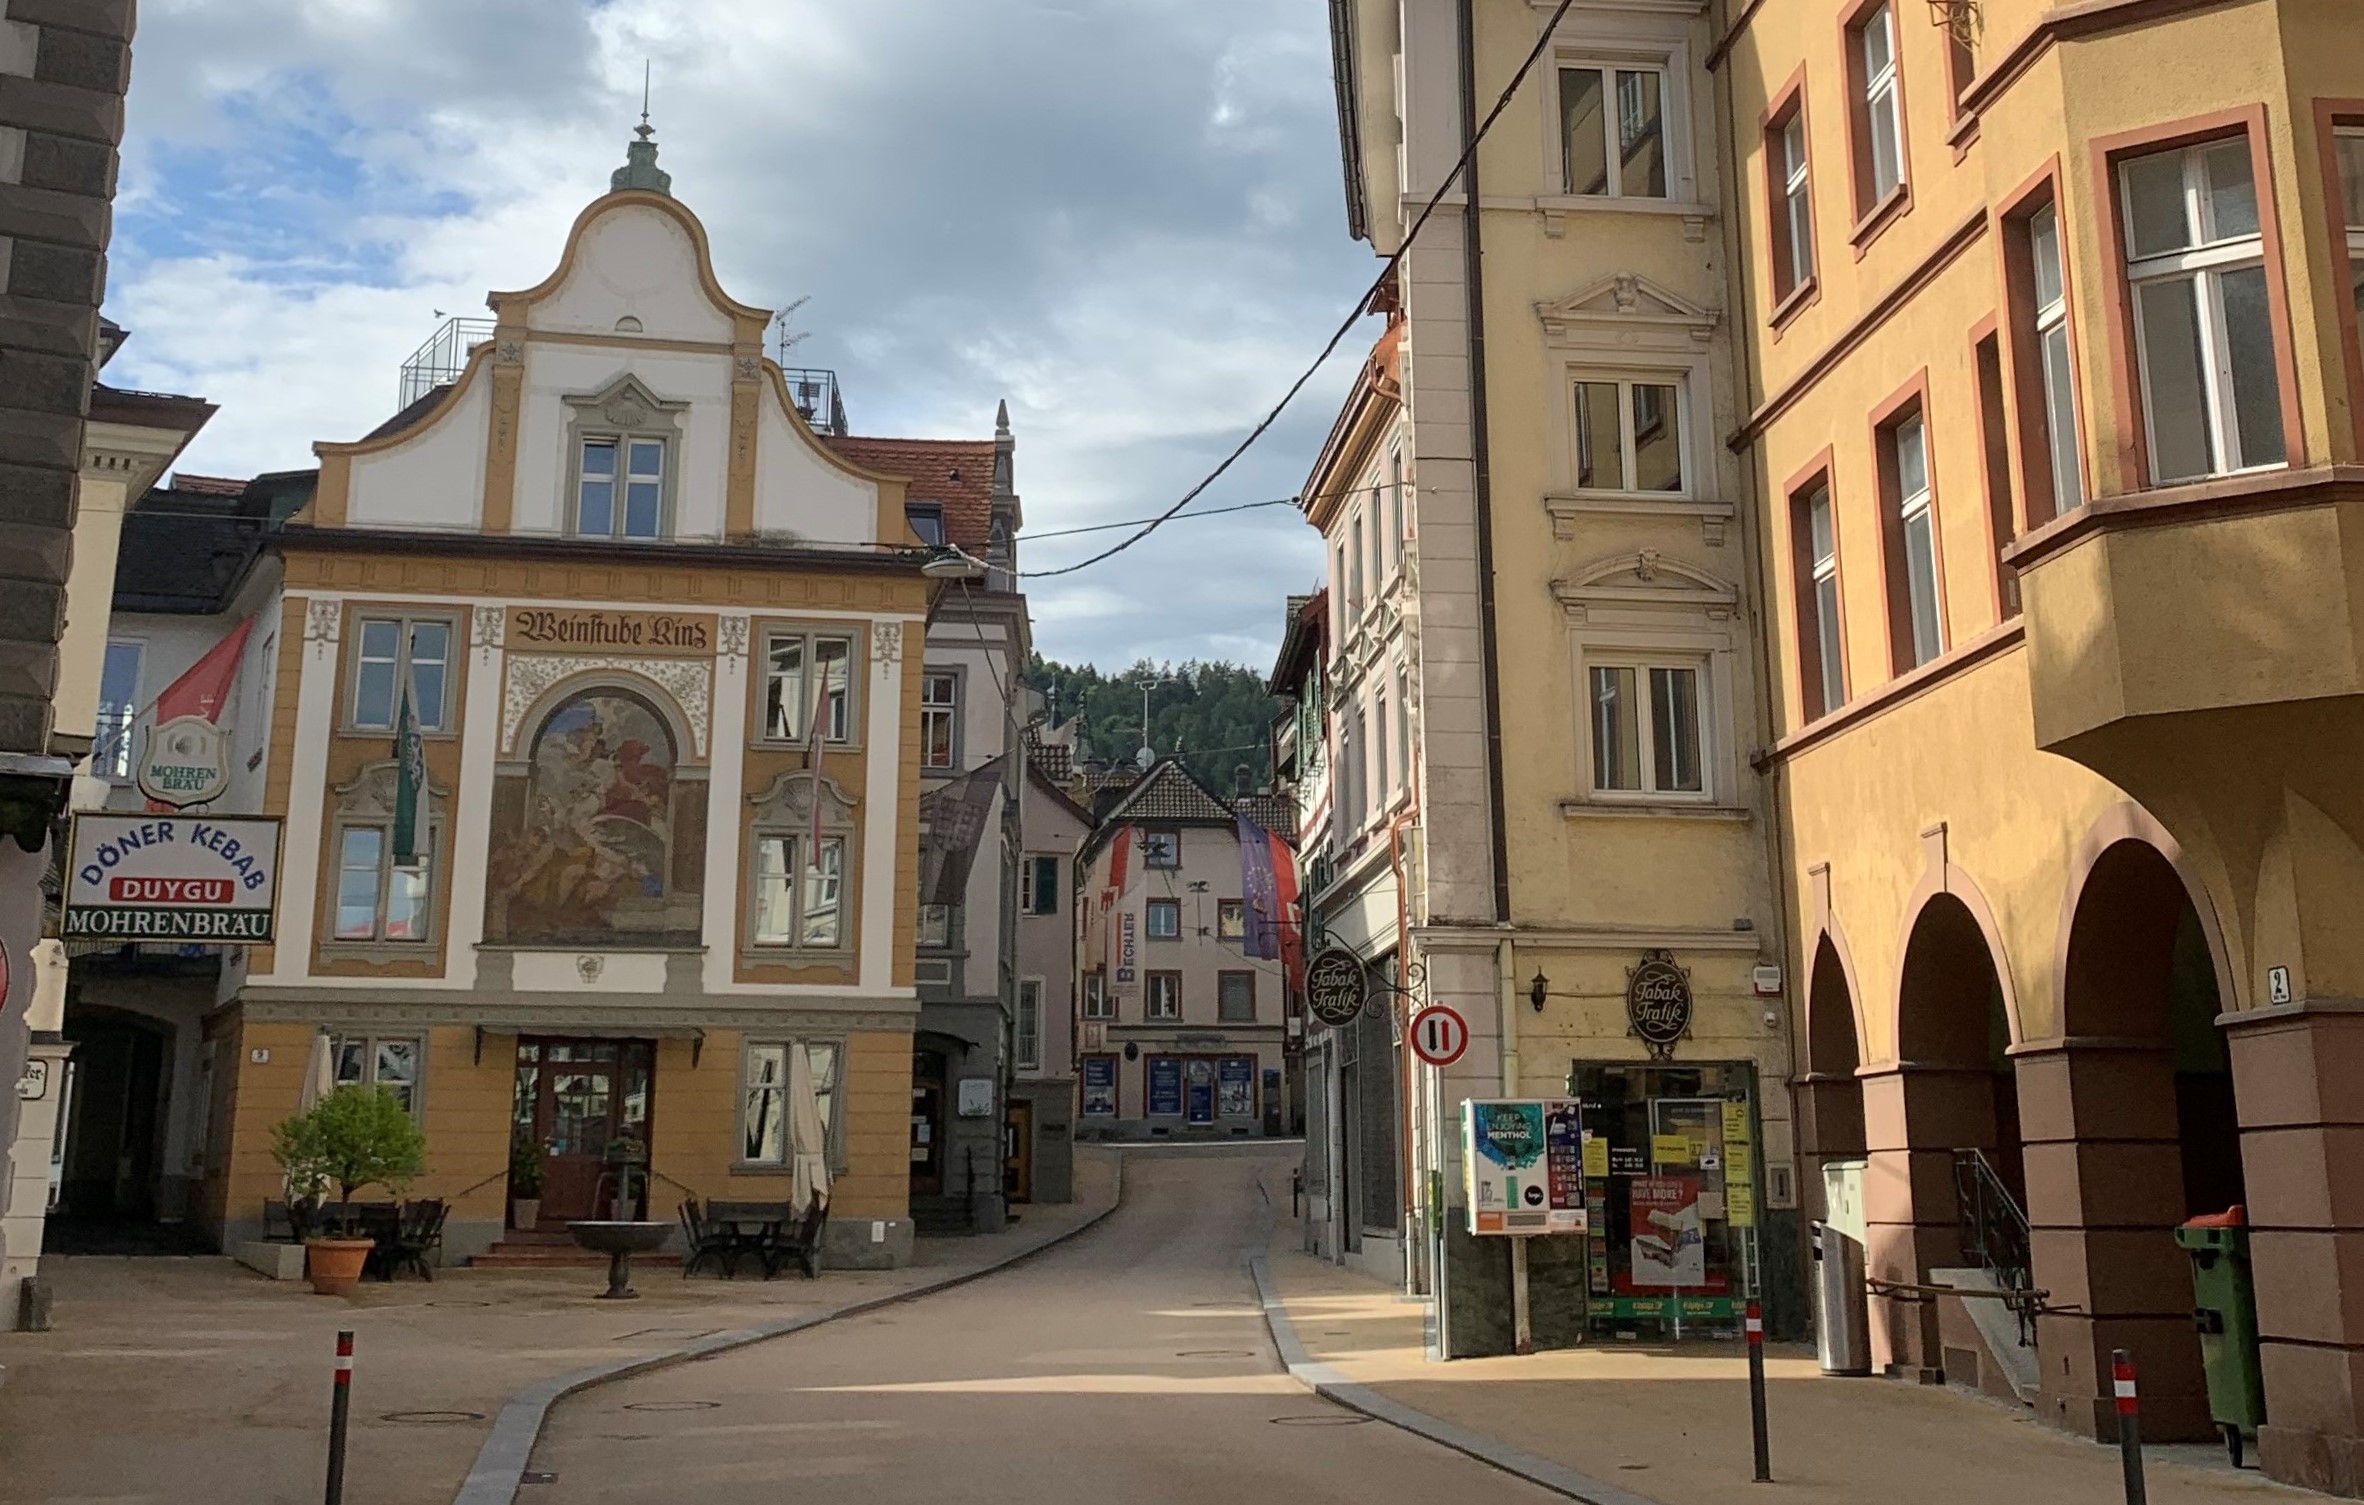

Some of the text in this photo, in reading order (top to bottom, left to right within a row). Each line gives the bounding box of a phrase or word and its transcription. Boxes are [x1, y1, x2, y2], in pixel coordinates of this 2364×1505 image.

[648, 615, 707, 649] Kinz
[150, 764, 217, 780] MOHREN
[162, 777, 205, 791] BRÄU
[80, 821, 265, 890] DÖNER KEBAB
[122, 880, 222, 900] DUYGU
[66, 909, 270, 937] MOHRENBRÄU
[1116, 912, 1135, 982] BECHTER
[1311, 966, 1360, 989] Tabak
[2273, 970, 2282, 995] 2
[1312, 988, 1360, 1012] Trafik
[1634, 979, 1684, 1002] Tabak
[1635, 1002, 1684, 1024] Trafik
[1486, 1121, 1533, 1131] ENJOYING
[1496, 1113, 1521, 1121] KEEP
[1486, 1130, 1533, 1140] MENTHOL
